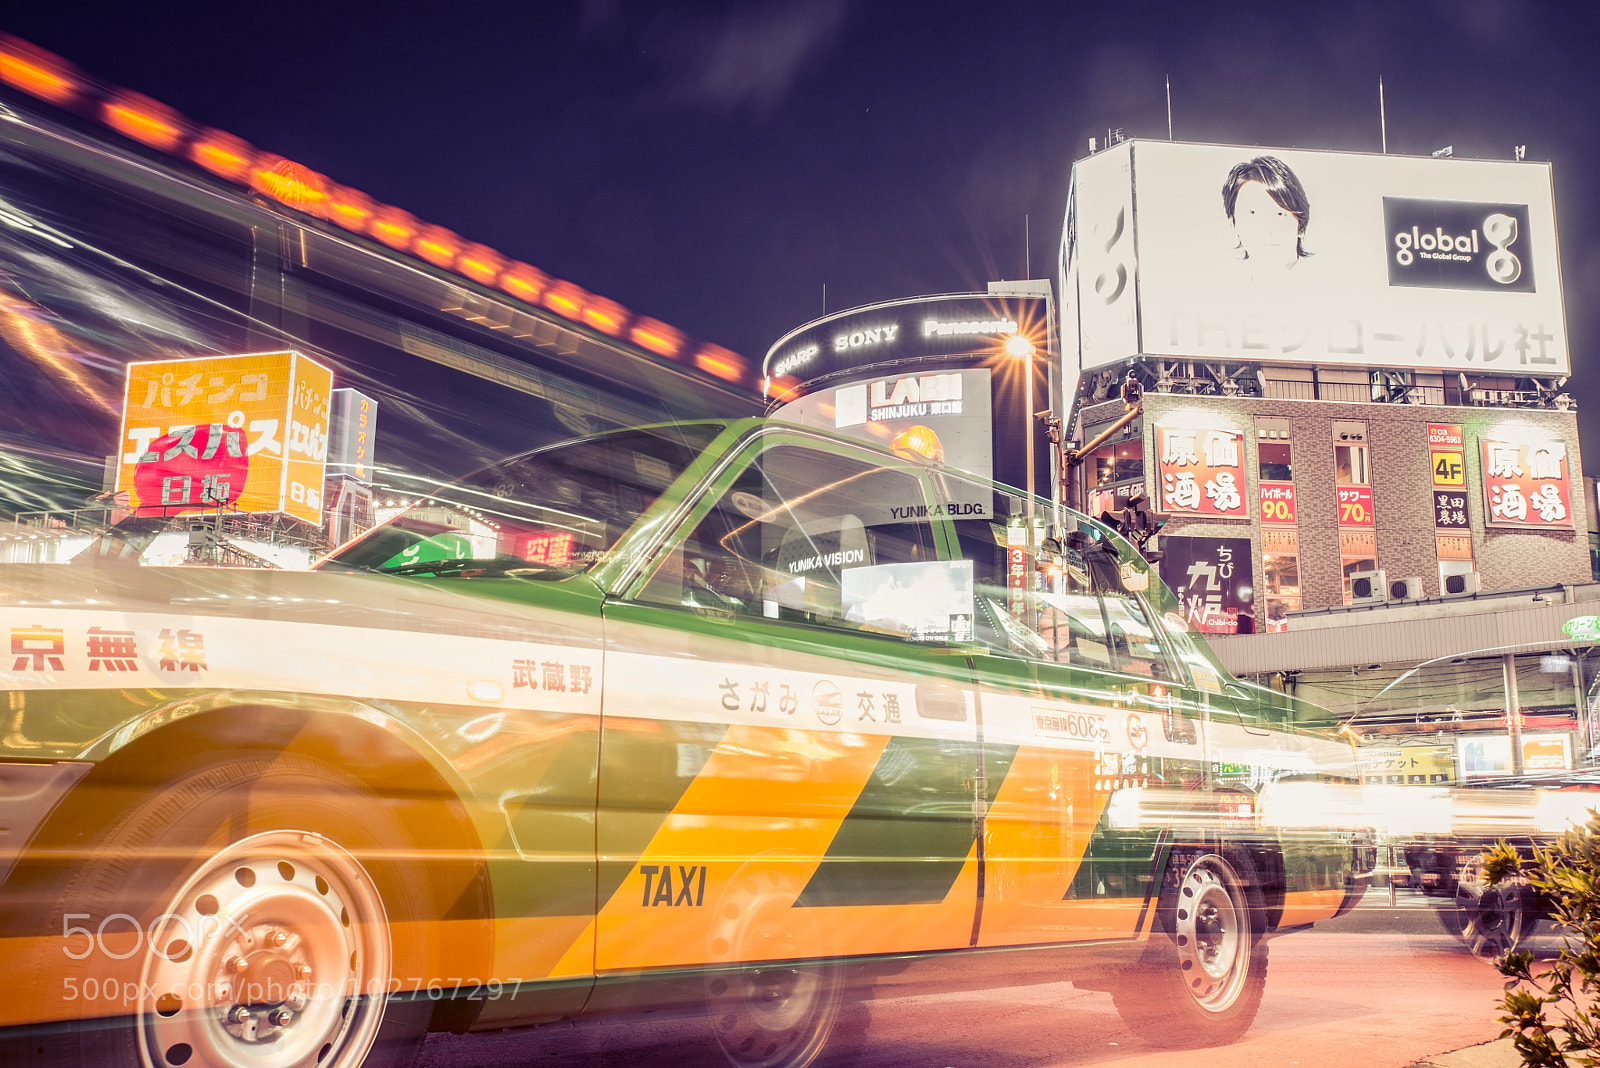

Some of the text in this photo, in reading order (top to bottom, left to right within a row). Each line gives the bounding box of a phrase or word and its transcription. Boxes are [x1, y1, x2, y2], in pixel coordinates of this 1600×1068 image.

[1395, 225, 1479, 266] global
[1433, 252, 1451, 260] Global
[1453, 254, 1472, 262] Group
[774, 318, 1018, 377] SHARP SONY Panasonic
[142, 372, 268, 409] パチンコ
[294, 379, 328, 420] パチンコ
[870, 373, 962, 408] LABI
[871, 403, 927, 421] SHINJUKU
[124, 410, 282, 464] エスパス
[290, 421, 327, 461] エスパス
[1161, 429, 1240, 468] 原価
[1429, 434, 1461, 444] 6304-5963
[1435, 458, 1462, 479] 4F
[1487, 442, 1566, 480] 原価
[1164, 472, 1241, 512] 酒場
[1260, 488, 1292, 500] ハイボール
[1338, 490, 1370, 501] サワー
[1437, 495, 1464, 509] 黒田
[1491, 483, 1566, 522] 酒場
[891, 503, 986, 519] YUNIKA BLDG.
[1438, 509, 1466, 525] 農場
[789, 549, 864, 573] YUNIKA VISION
[1217, 545, 1234, 579] ちび
[10, 624, 208, 672] 京無線
[512, 658, 592, 694] 武蔵野
[718, 677, 902, 723] さがみ 交通
[640, 865, 707, 907] TAXI
